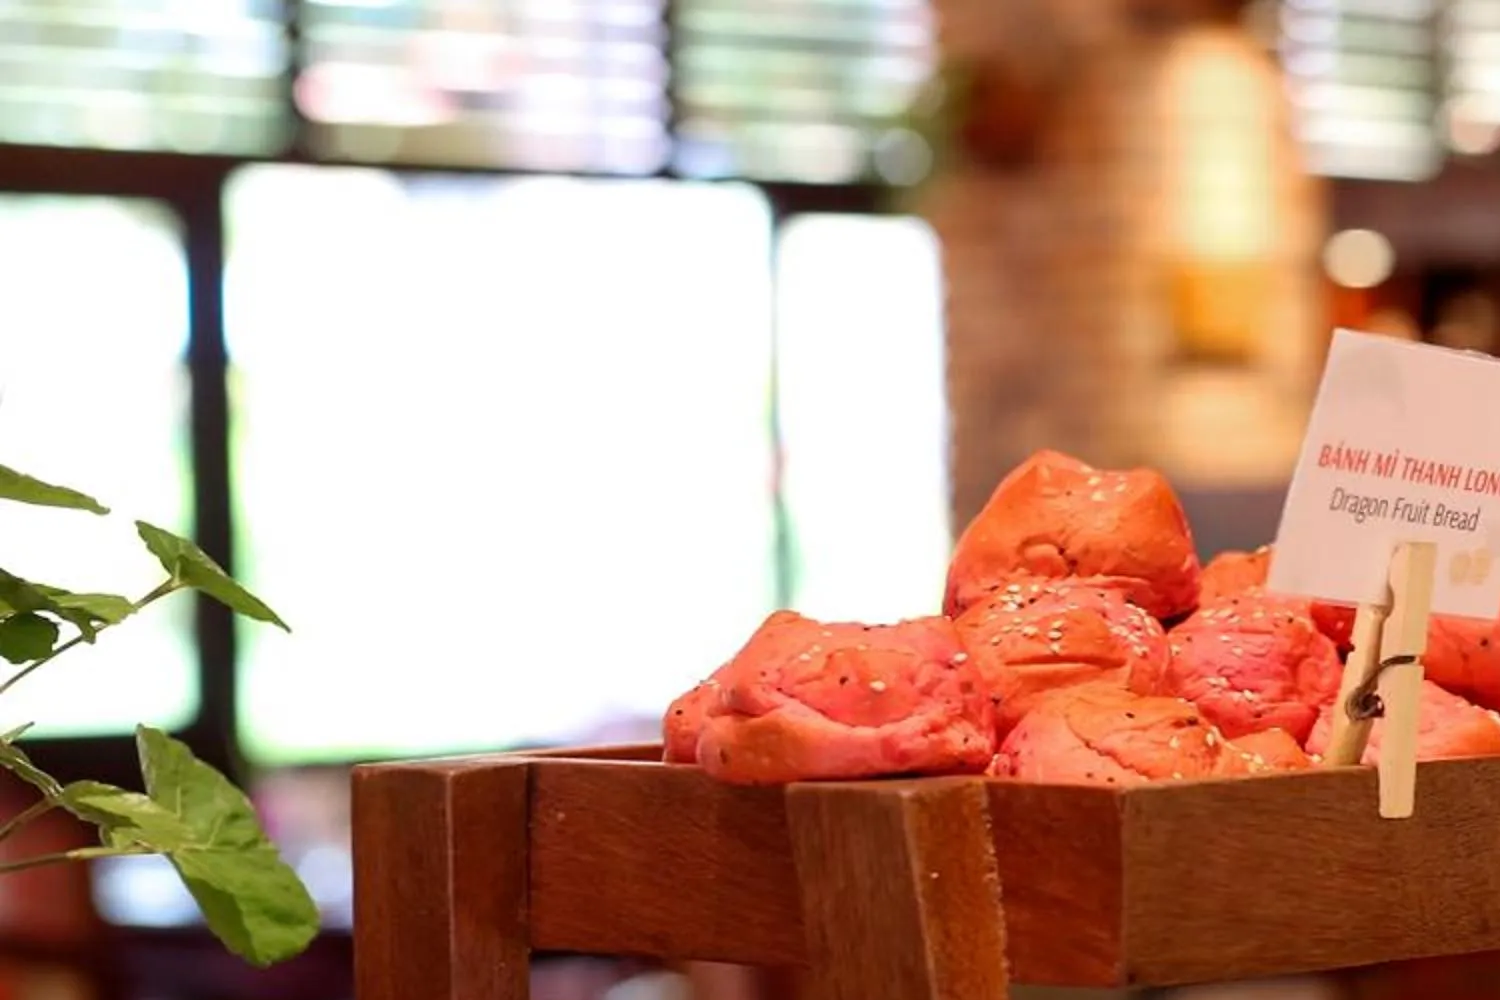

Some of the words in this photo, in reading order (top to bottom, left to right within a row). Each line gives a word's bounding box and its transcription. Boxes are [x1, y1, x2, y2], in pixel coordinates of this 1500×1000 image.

[1318, 440, 1370, 474] BÁNH
[1403, 457, 1463, 489] THANH
[1330, 487, 1388, 524] Dragon
[1391, 497, 1430, 525] Fruit
[1432, 503, 1481, 532] Bread
